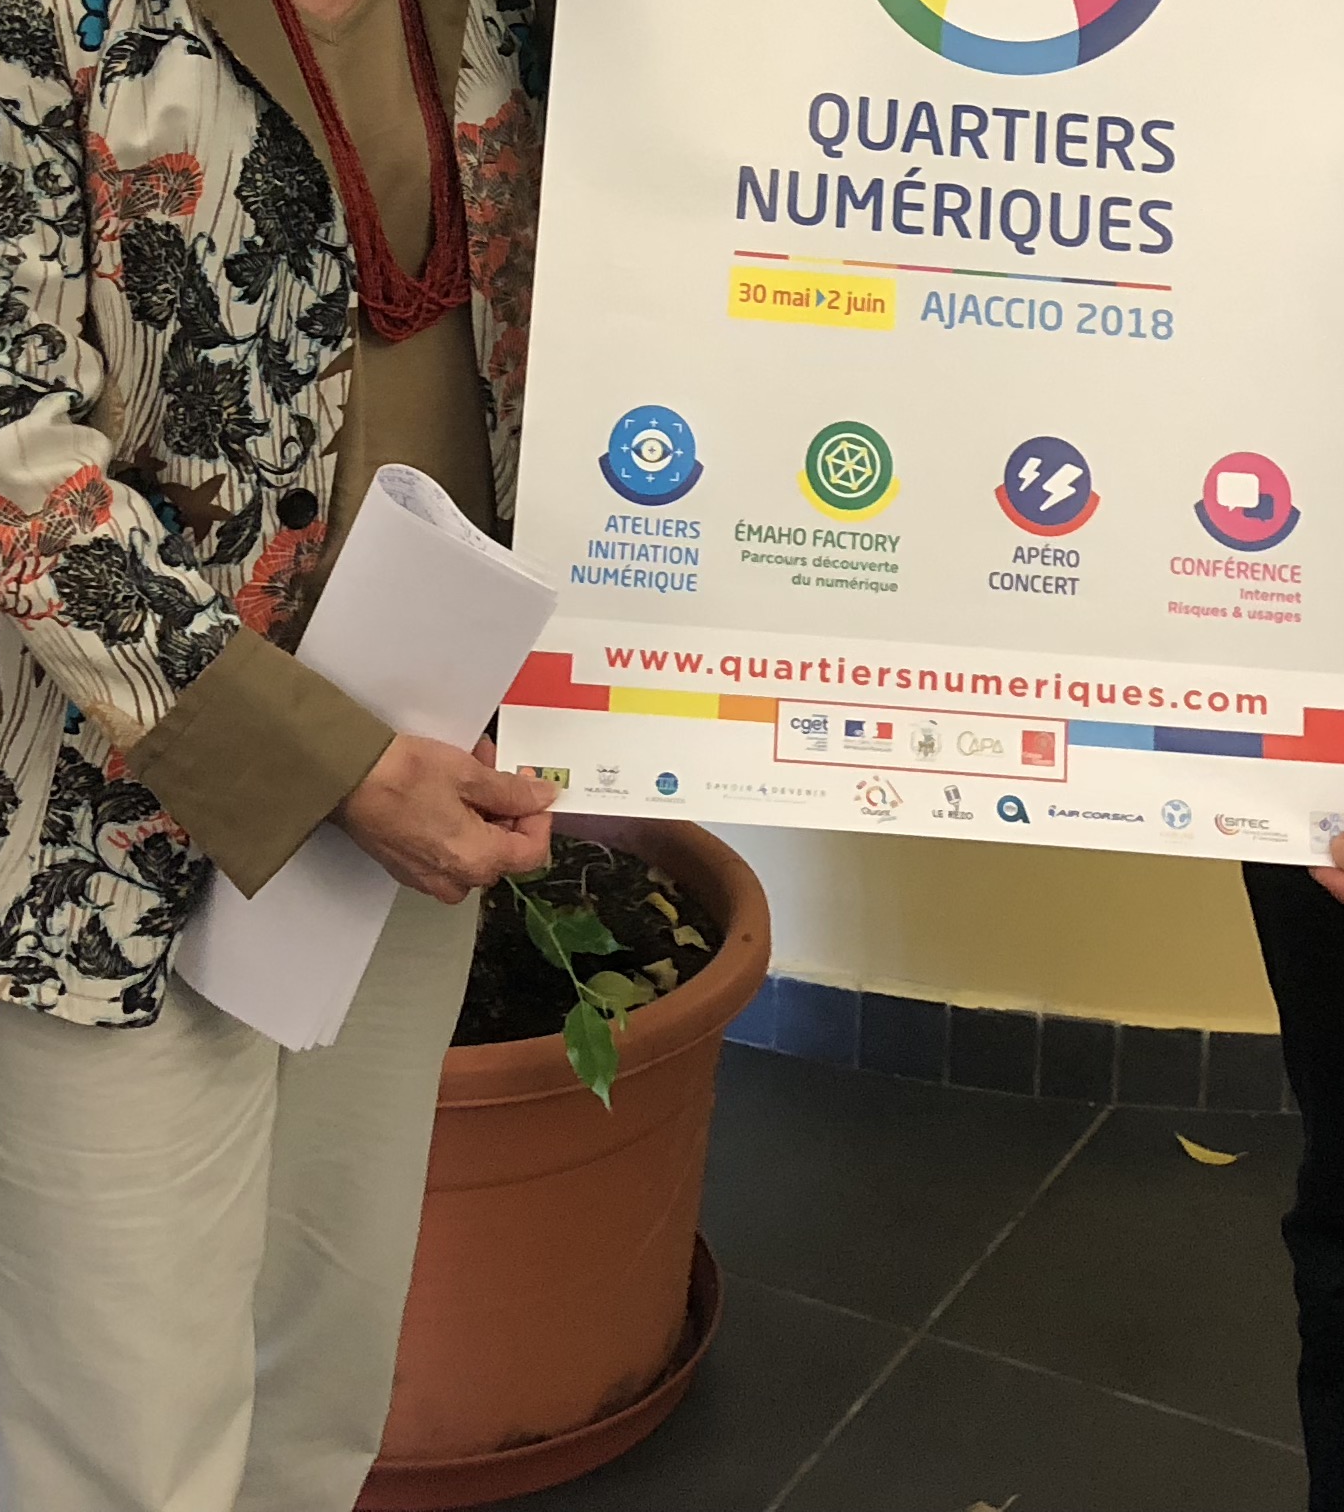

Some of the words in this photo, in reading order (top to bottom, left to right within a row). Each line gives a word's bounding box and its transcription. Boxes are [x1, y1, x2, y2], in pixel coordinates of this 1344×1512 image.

[808, 92, 1176, 174] QUARTIERS
[735, 165, 1174, 256] NUMÉRIQUES
[738, 283, 767, 304] 30
[772, 287, 811, 308] mai
[826, 293, 840, 311] 2
[845, 294, 886, 316] juin
[920, 291, 1063, 330] AJACCIO
[1076, 302, 1175, 341] 2018
[605, 514, 701, 539] ATELIERS
[734, 520, 807, 546] ÉMAHO
[812, 528, 901, 553] FACTORY
[587, 539, 699, 566] INITIATION
[741, 549, 807, 567] Parcours
[812, 554, 899, 574] découverte
[1012, 543, 1080, 569] APÉRO
[570, 564, 698, 594] NUMÉRIQUE
[791, 572, 811, 587] du
[815, 574, 899, 593] numérique
[1169, 555, 1302, 584] CONFÉRENCE
[988, 571, 1080, 596] CONCERT
[1239, 587, 1302, 605] Internet
[1168, 600, 1228, 619] Risques
[1232, 606, 1243, 619] &
[1247, 608, 1302, 624] usages
[604, 645, 1269, 716] www.quartiersnumeriques.com
[790, 716, 828, 735] cget
[1056, 808, 1080, 819] AIR
[1082, 810, 1145, 823] CORSICA
[1224, 816, 1270, 830] SITEC
